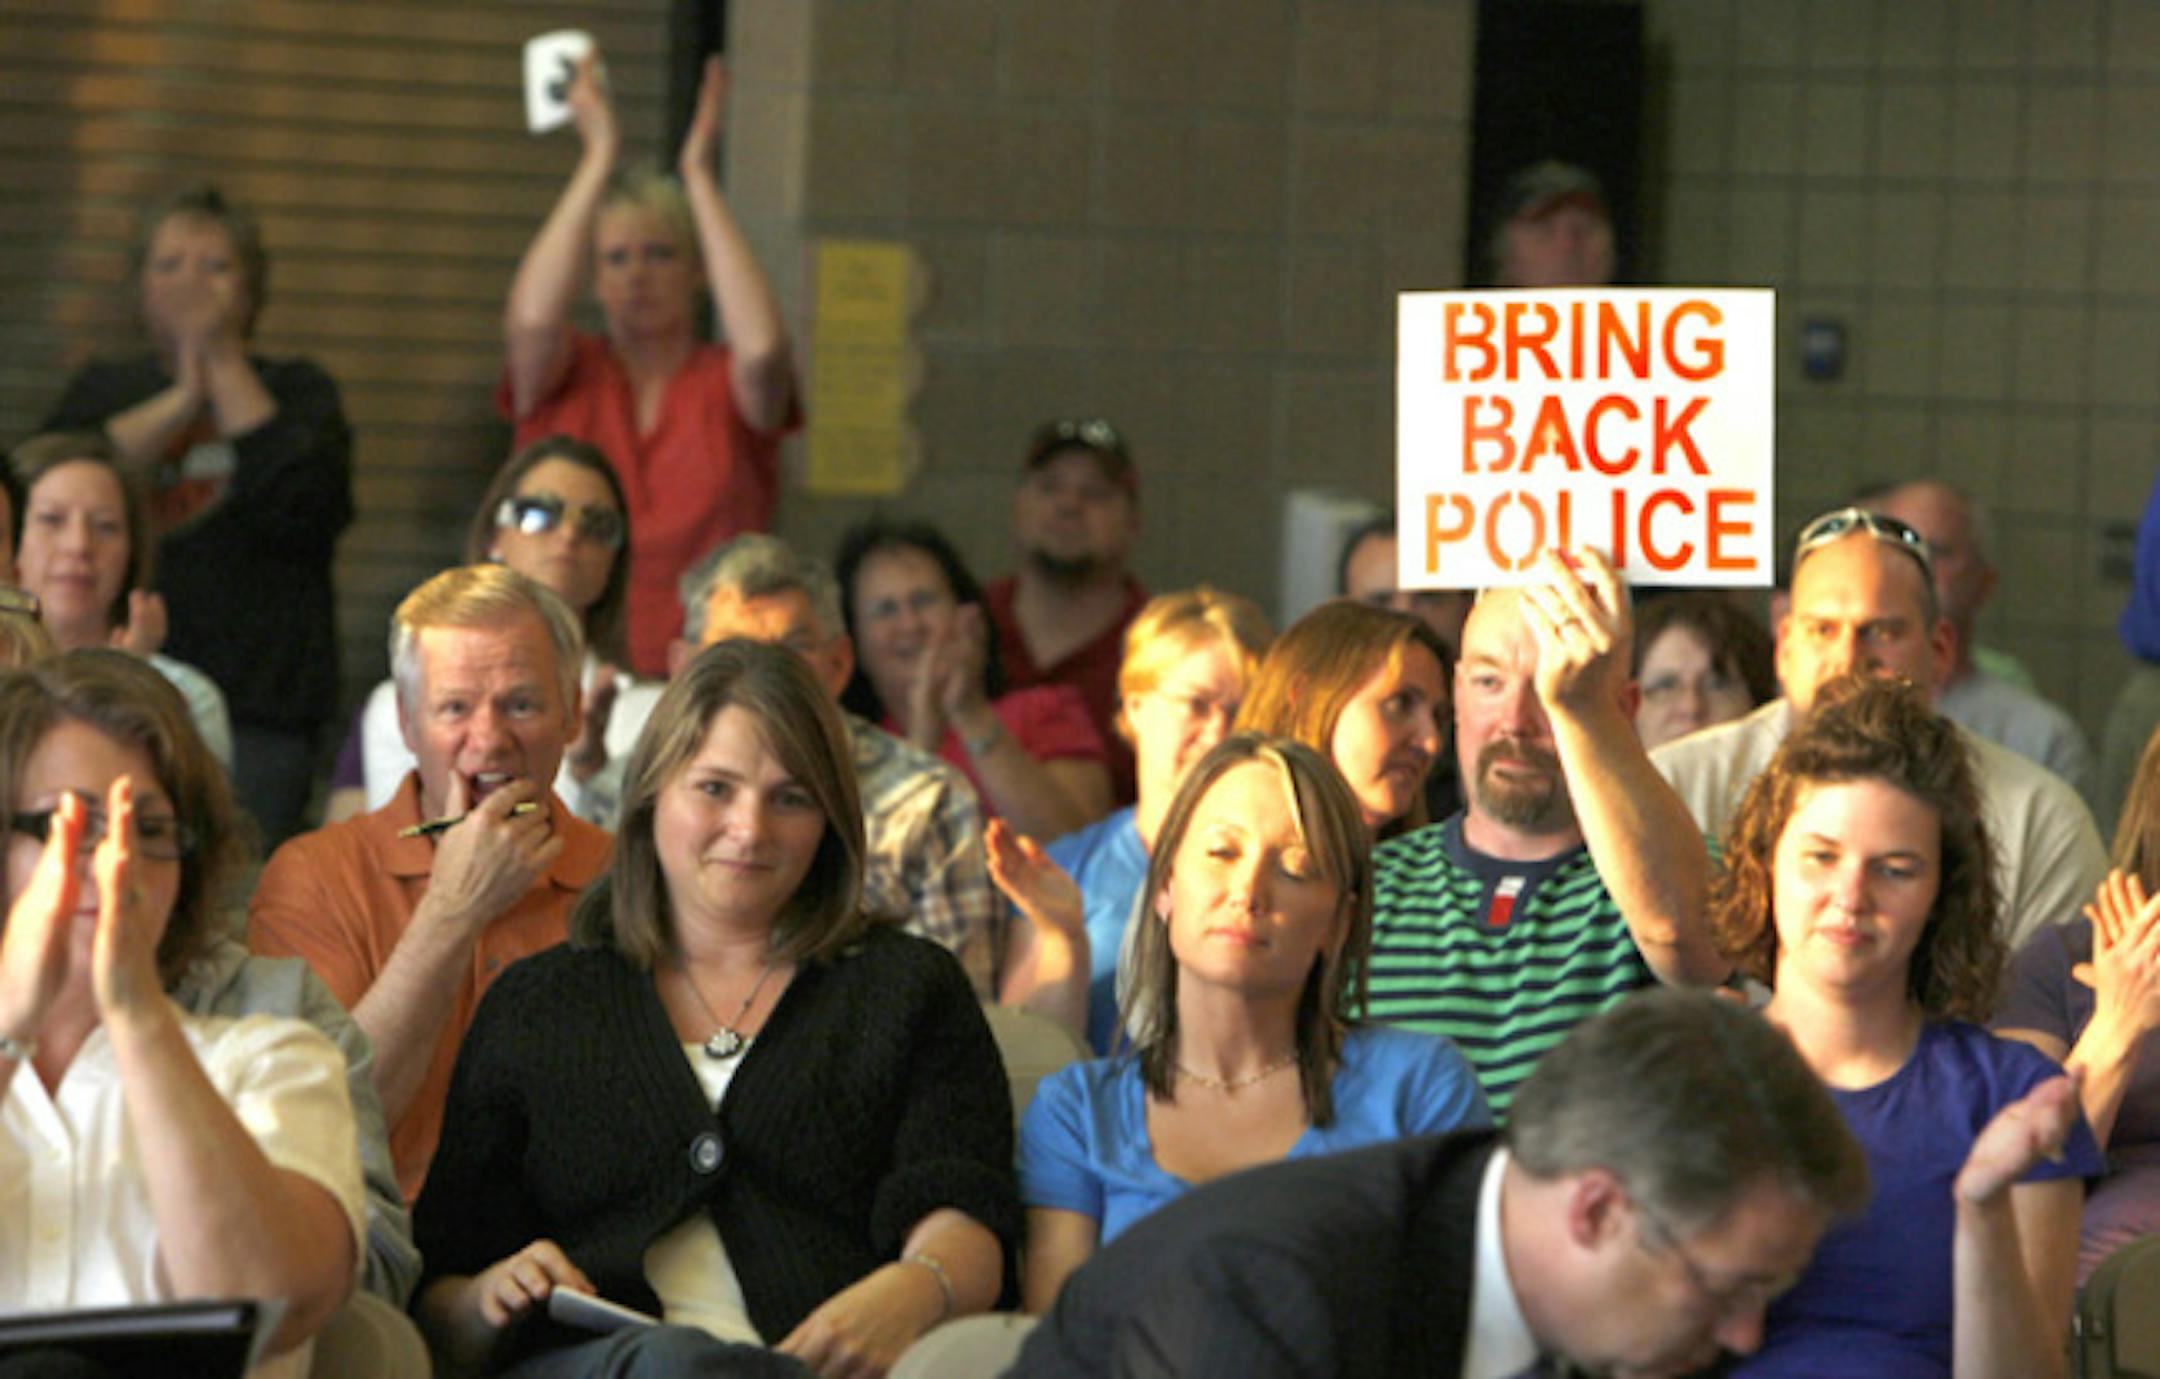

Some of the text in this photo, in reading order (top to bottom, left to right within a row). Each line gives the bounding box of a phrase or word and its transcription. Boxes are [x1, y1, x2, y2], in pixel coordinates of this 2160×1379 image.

[1442, 300, 1725, 382] BRING
[1461, 394, 1712, 476] BACK
[1425, 488, 1758, 573] POLICE
